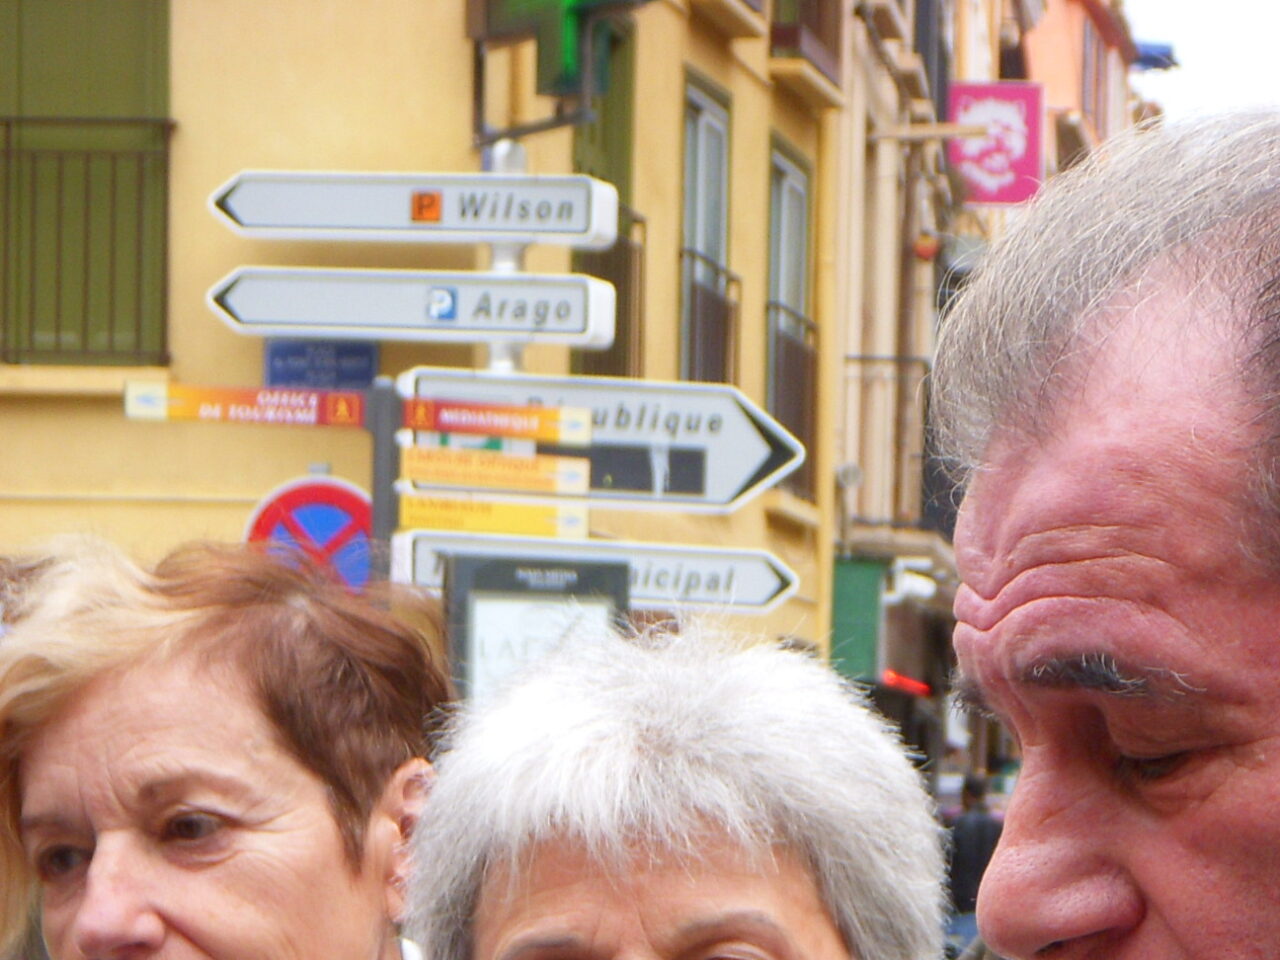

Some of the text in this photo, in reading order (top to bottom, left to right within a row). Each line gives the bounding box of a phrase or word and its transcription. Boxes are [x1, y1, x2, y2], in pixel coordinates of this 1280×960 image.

[459, 192, 574, 221] Wilson
[473, 291, 571, 326] Arago
[527, 396, 723, 438] ublique
[630, 562, 736, 597] icipal
